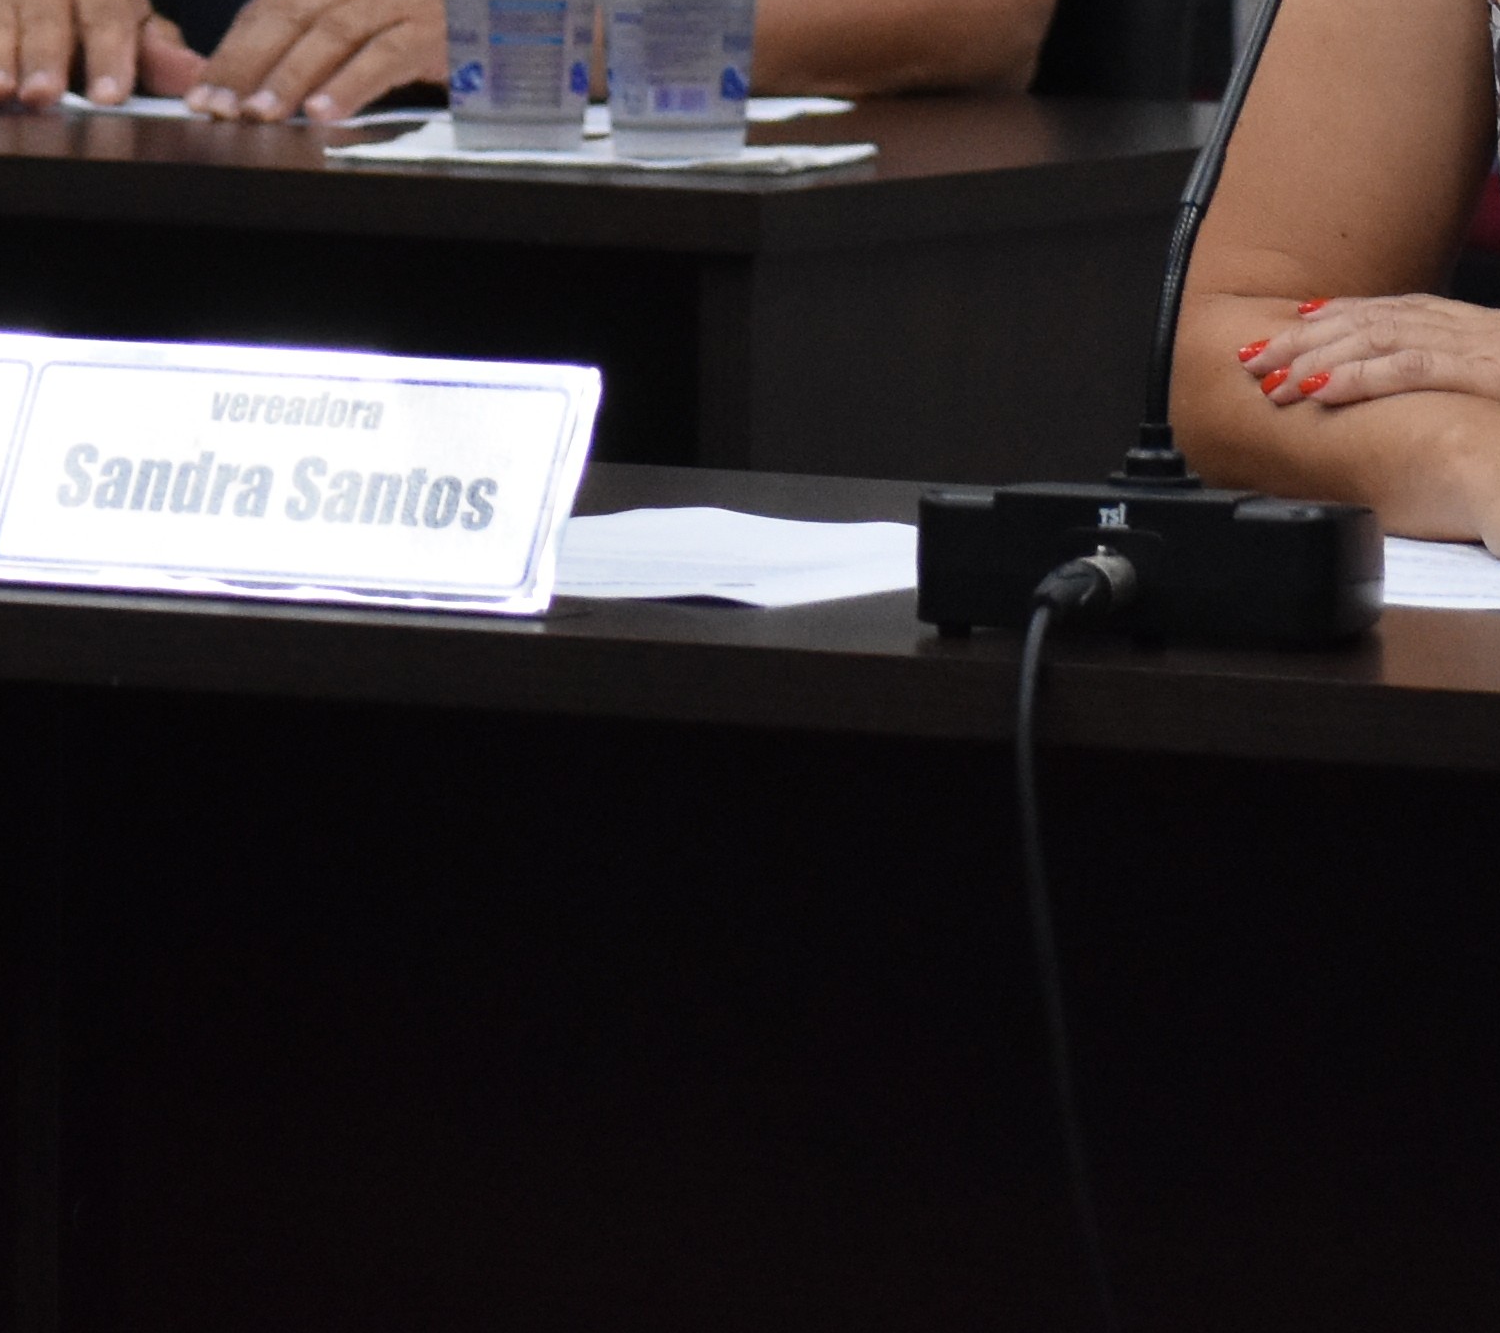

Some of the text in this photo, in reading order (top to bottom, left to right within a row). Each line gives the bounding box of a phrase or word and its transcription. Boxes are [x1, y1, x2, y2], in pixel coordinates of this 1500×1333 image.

[210, 390, 384, 430] vereadora
[56, 442, 498, 531] Sandra Santos
